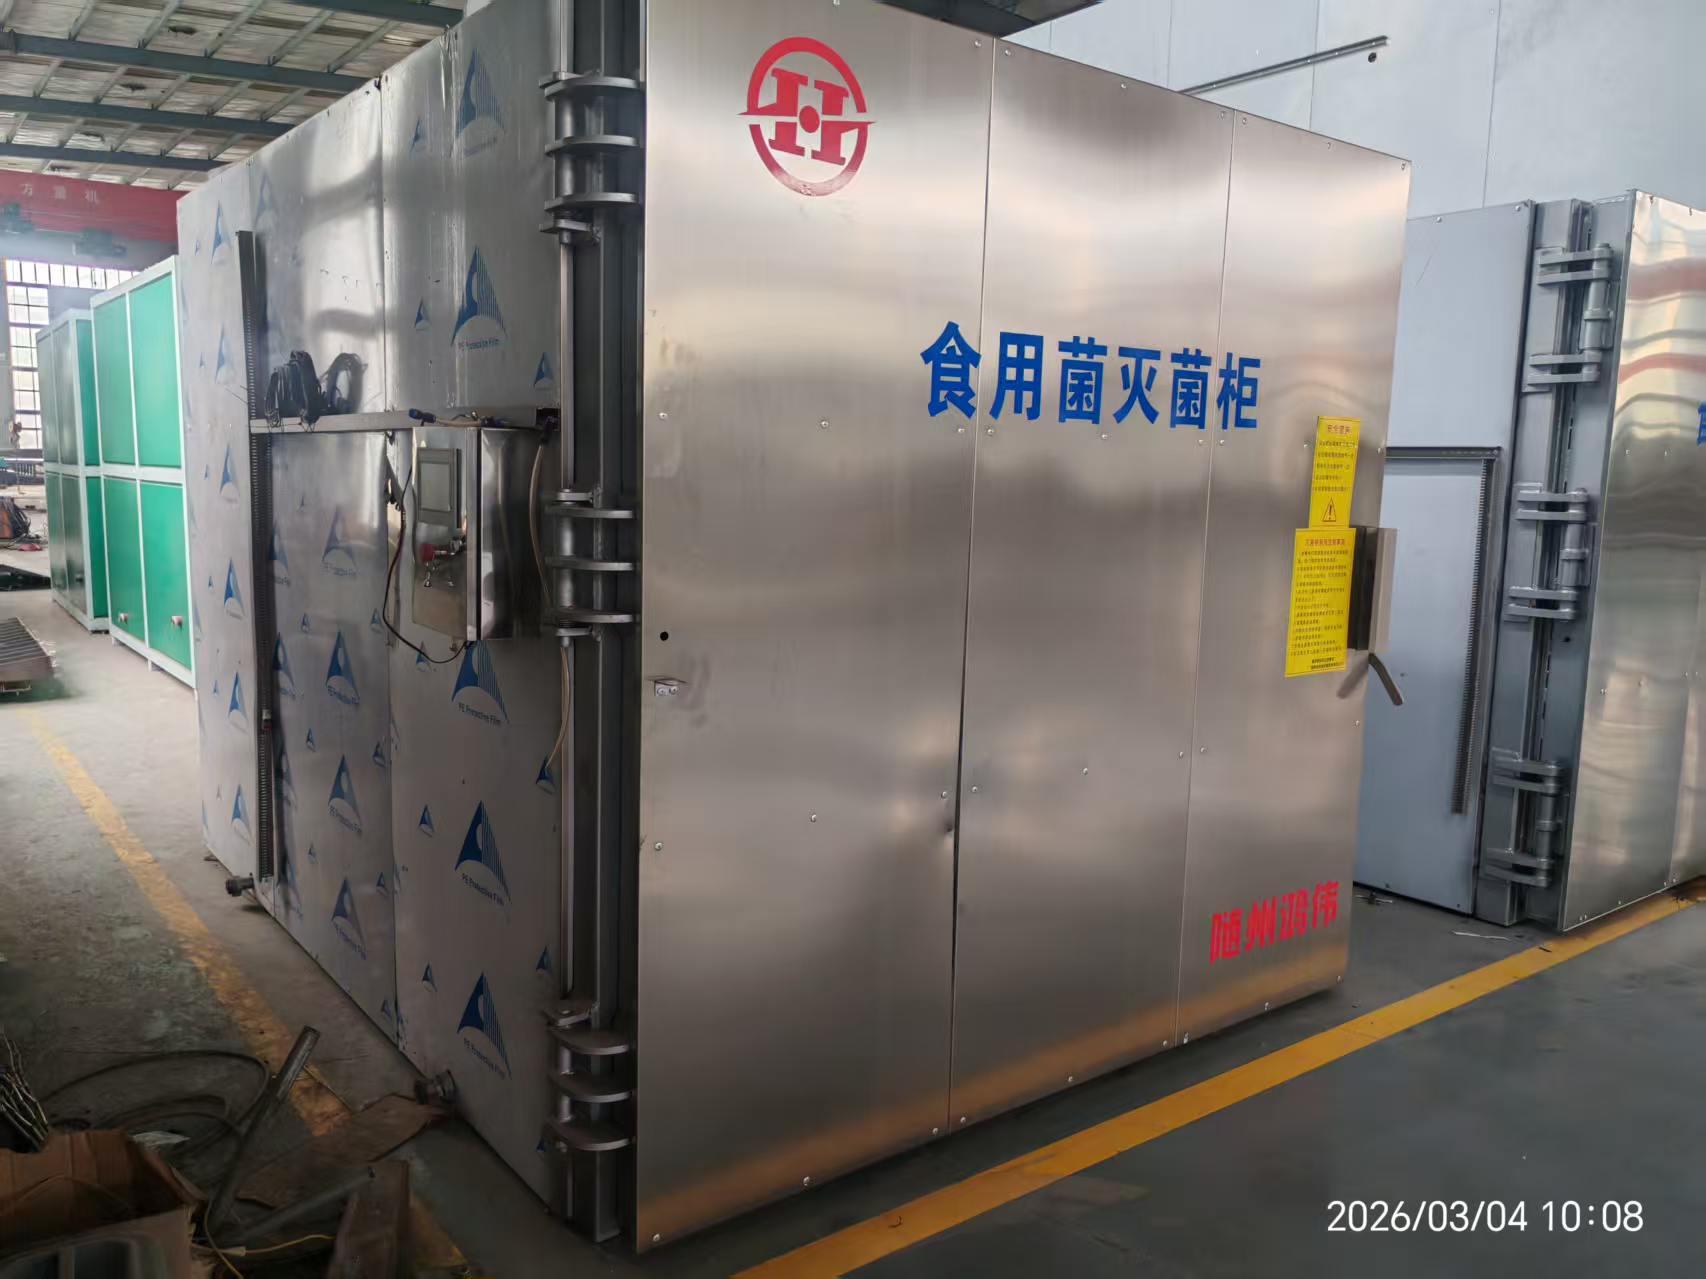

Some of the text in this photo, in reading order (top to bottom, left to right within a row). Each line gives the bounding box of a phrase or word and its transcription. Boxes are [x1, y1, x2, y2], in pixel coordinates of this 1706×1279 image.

[920, 321, 1261, 430] 食用菌灭菌柜
[1209, 880, 1339, 966] 随州鸿伟
